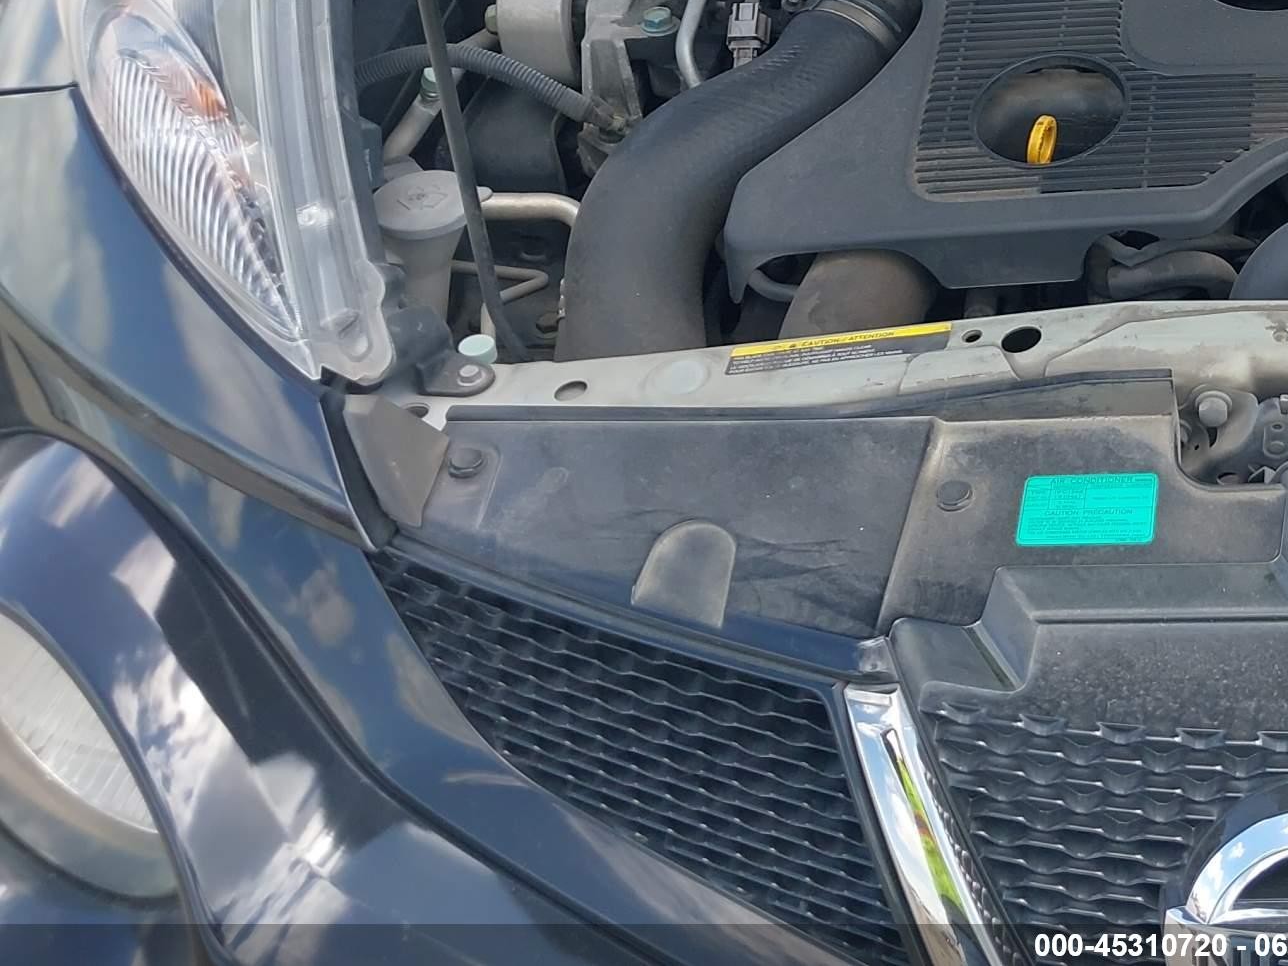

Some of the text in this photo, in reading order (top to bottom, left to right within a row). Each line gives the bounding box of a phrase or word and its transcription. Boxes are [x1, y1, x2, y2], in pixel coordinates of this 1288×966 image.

[801, 337, 840, 347] CAUTION
[848, 333, 895, 342] ATTENTION
[1051, 475, 1133, 484] AIR CONDITIONER
